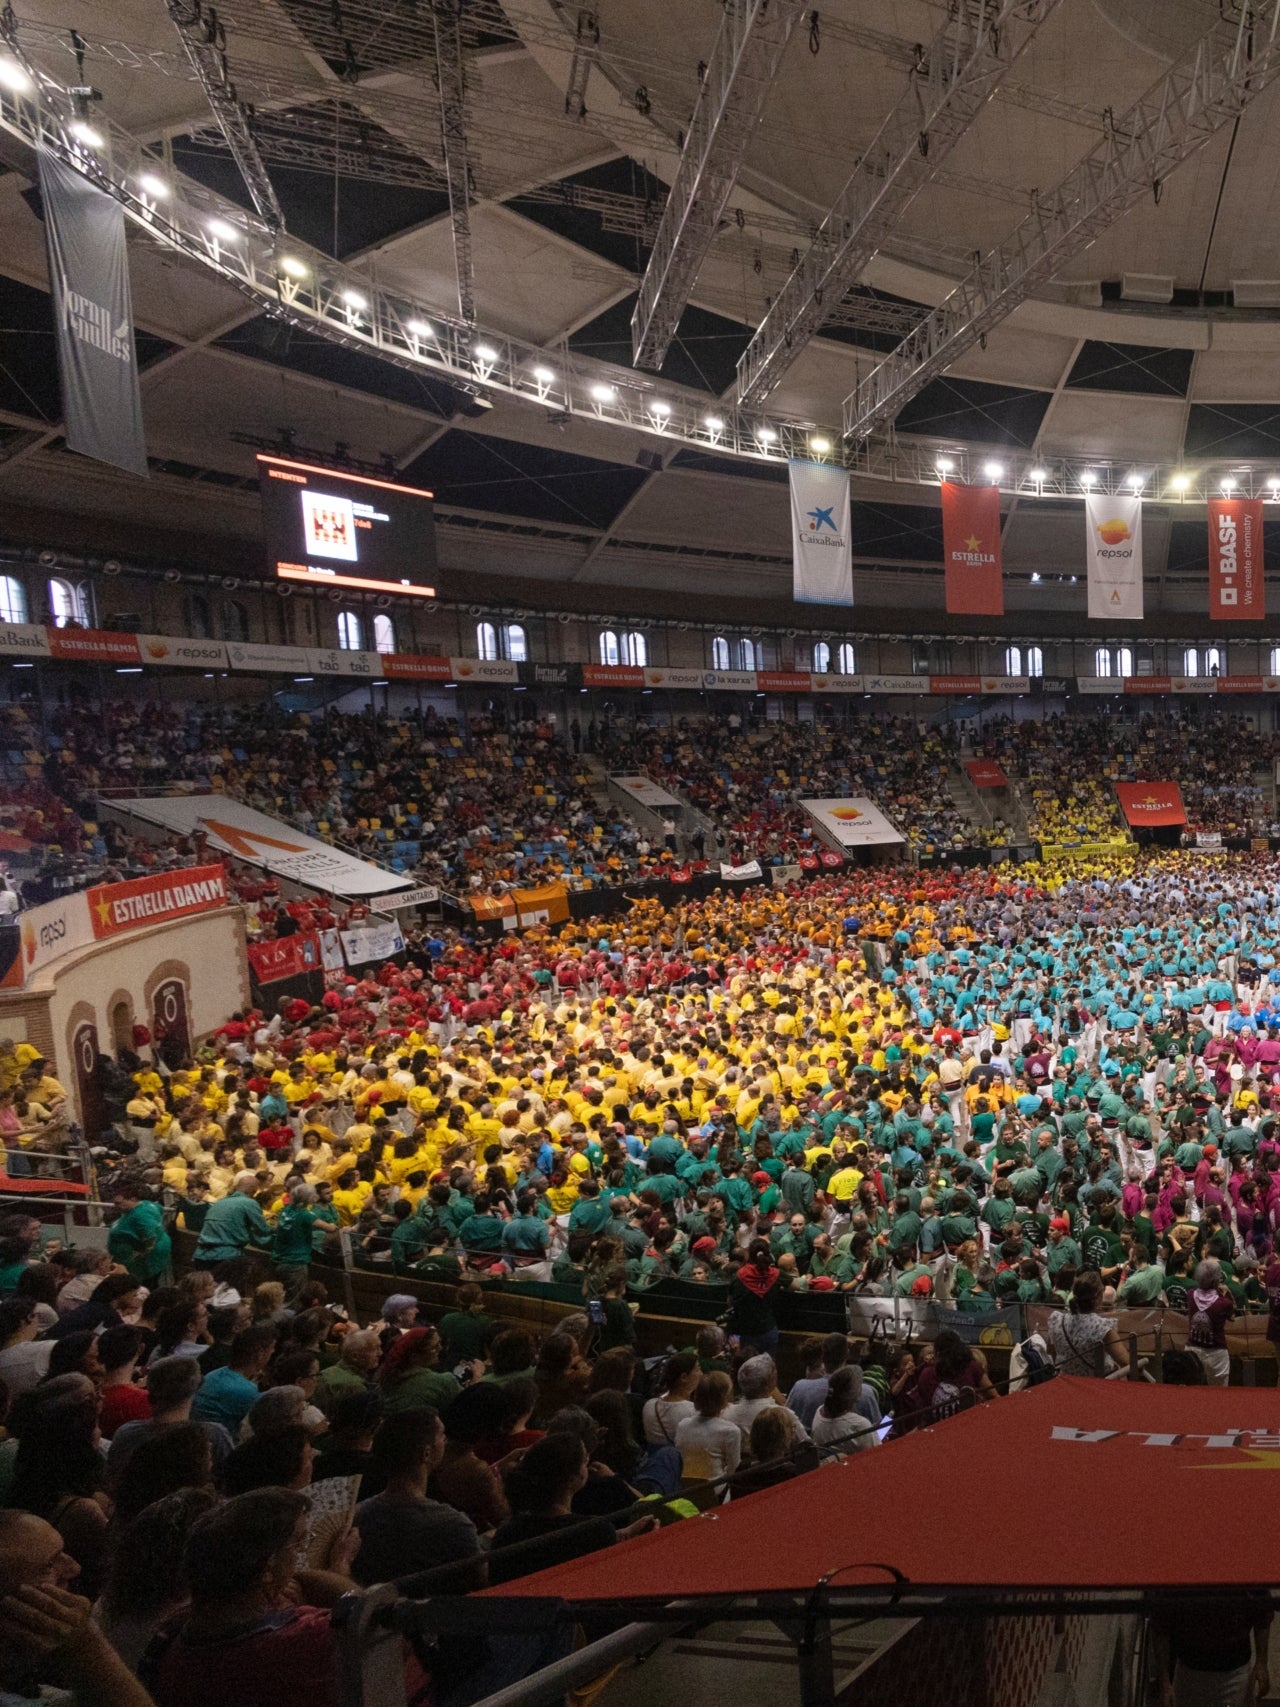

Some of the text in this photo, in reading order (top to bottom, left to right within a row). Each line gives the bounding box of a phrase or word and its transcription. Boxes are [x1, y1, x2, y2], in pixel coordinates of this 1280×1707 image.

[799, 533, 846, 549] CaixaBank
[1219, 514, 1237, 574] BASF
[952, 551, 995, 563] ESTRELLA
[1096, 548, 1133, 560] repsol
[1243, 514, 1253, 605] We create chemistry
[60, 640, 106, 651] ESTRELLA
[176, 647, 222, 660] repsol
[478, 668, 514, 676] repsol
[668, 675, 699, 684] repsol
[832, 679, 860, 688] repsol
[883, 681, 924, 689] CaixaBank
[1000, 681, 1026, 689] repsol
[1190, 682, 1214, 690] repsol
[837, 819, 872, 828] repsol
[113, 878, 225, 924] ESTRELLA DAMM
[401, 890, 434, 904] SANITARIS
